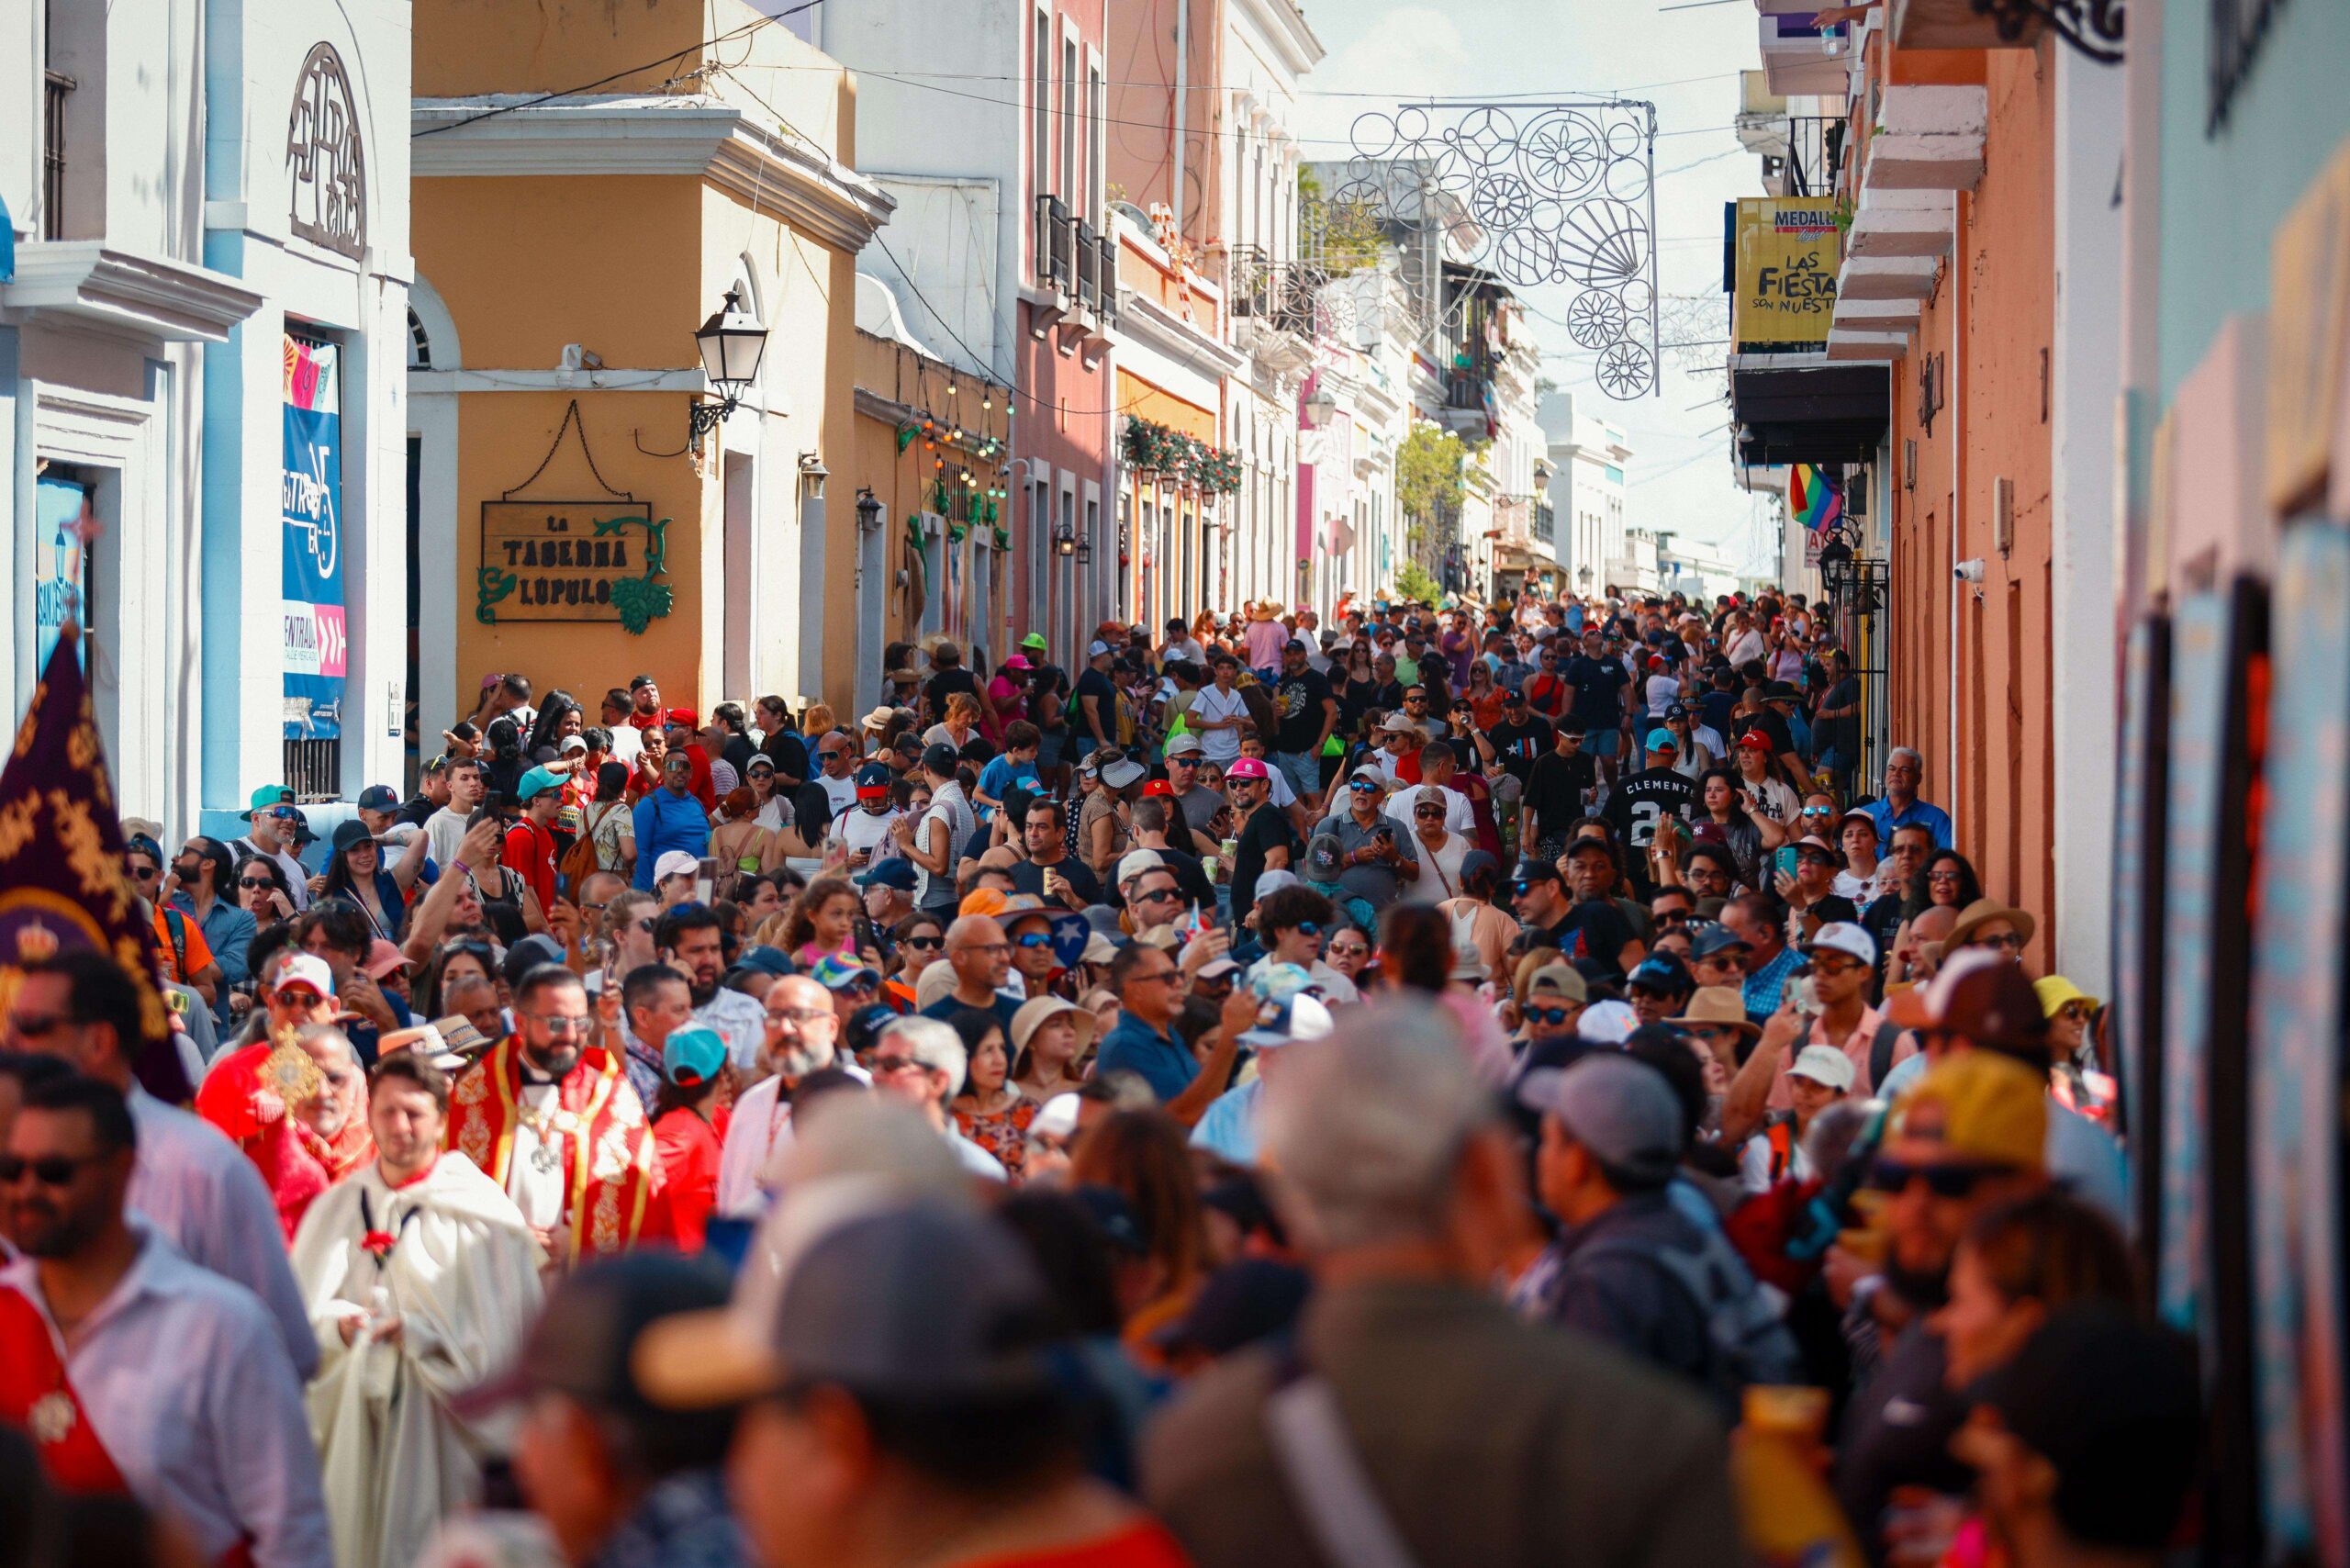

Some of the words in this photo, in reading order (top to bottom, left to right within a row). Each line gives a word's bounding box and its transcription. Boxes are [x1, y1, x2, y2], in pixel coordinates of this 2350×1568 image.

[1774, 210, 1837, 226] MEDALL
[1786, 252, 1819, 272] LAS
[1752, 298, 1774, 310] SON
[502, 539, 628, 568] TABERNA
[1626, 780, 1695, 798] CLEMENT
